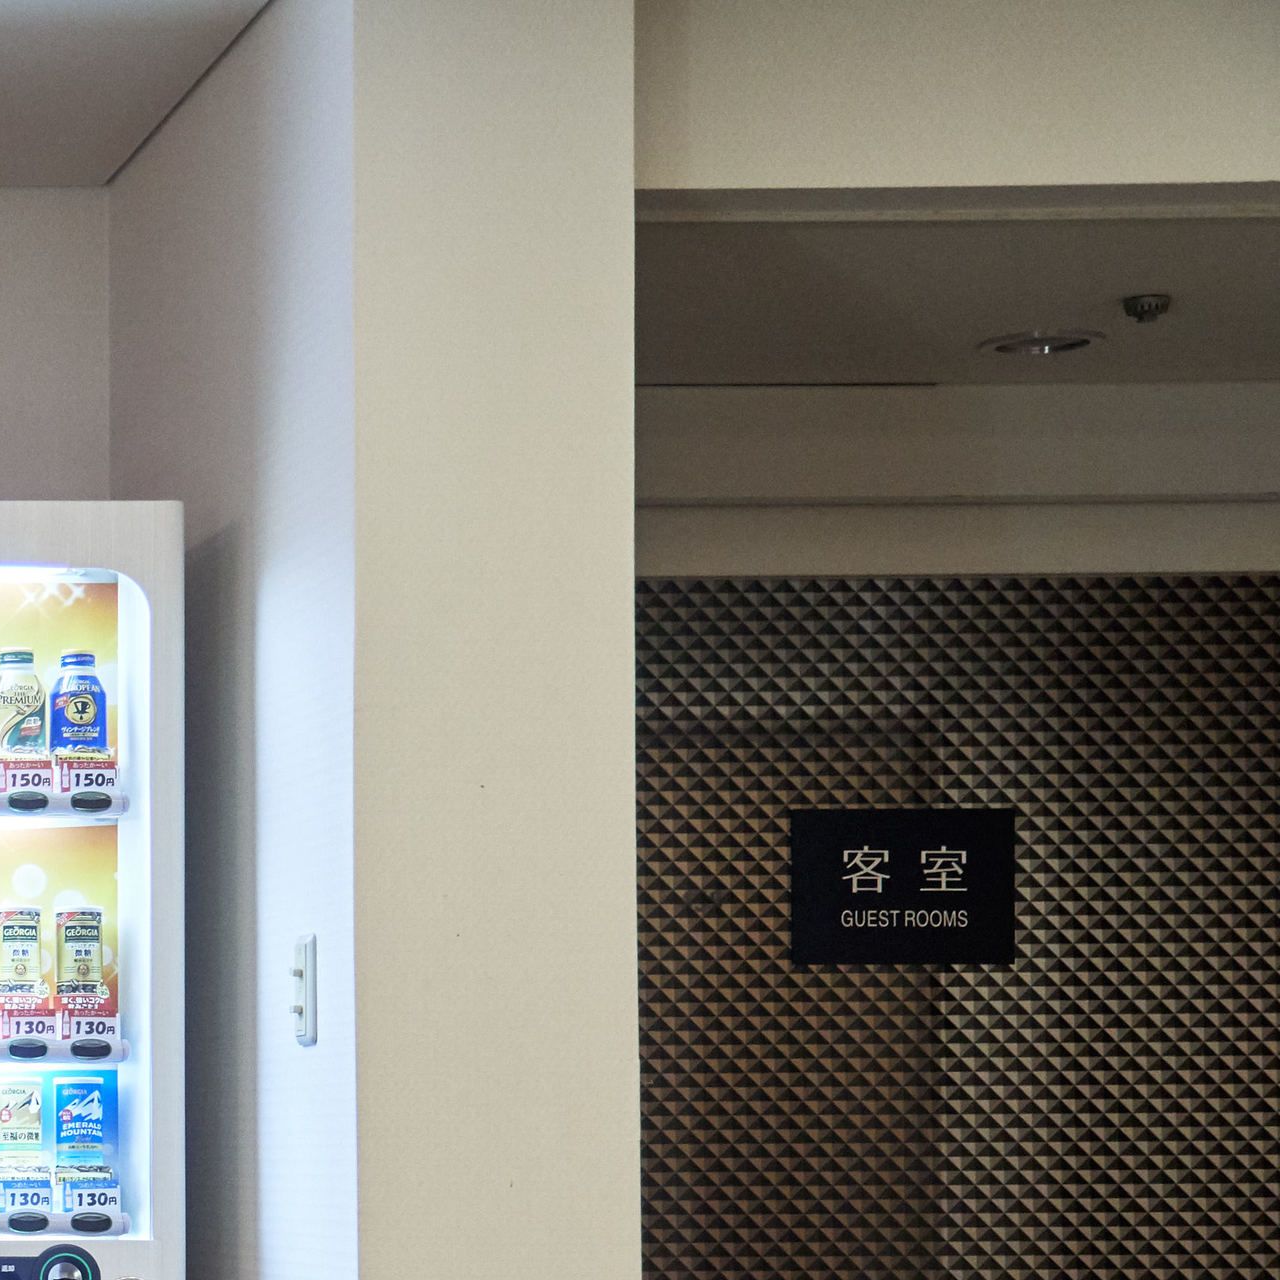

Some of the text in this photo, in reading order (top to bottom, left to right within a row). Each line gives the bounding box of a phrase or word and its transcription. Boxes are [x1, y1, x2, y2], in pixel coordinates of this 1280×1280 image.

[11, 774, 51, 788] 150円
[74, 774, 115, 788] 150円
[841, 844, 968, 894] 客室
[840, 909, 969, 928] GUEST ROOMS
[4, 926, 37, 937] GEORGIA
[66, 926, 98, 937] GEORGIA
[15, 1020, 55, 1034] 130円
[75, 1020, 115, 1034] 130円
[62, 1122, 102, 1130] EMERALD
[10, 1192, 50, 1206] 130円
[77, 1192, 118, 1206] 130円
